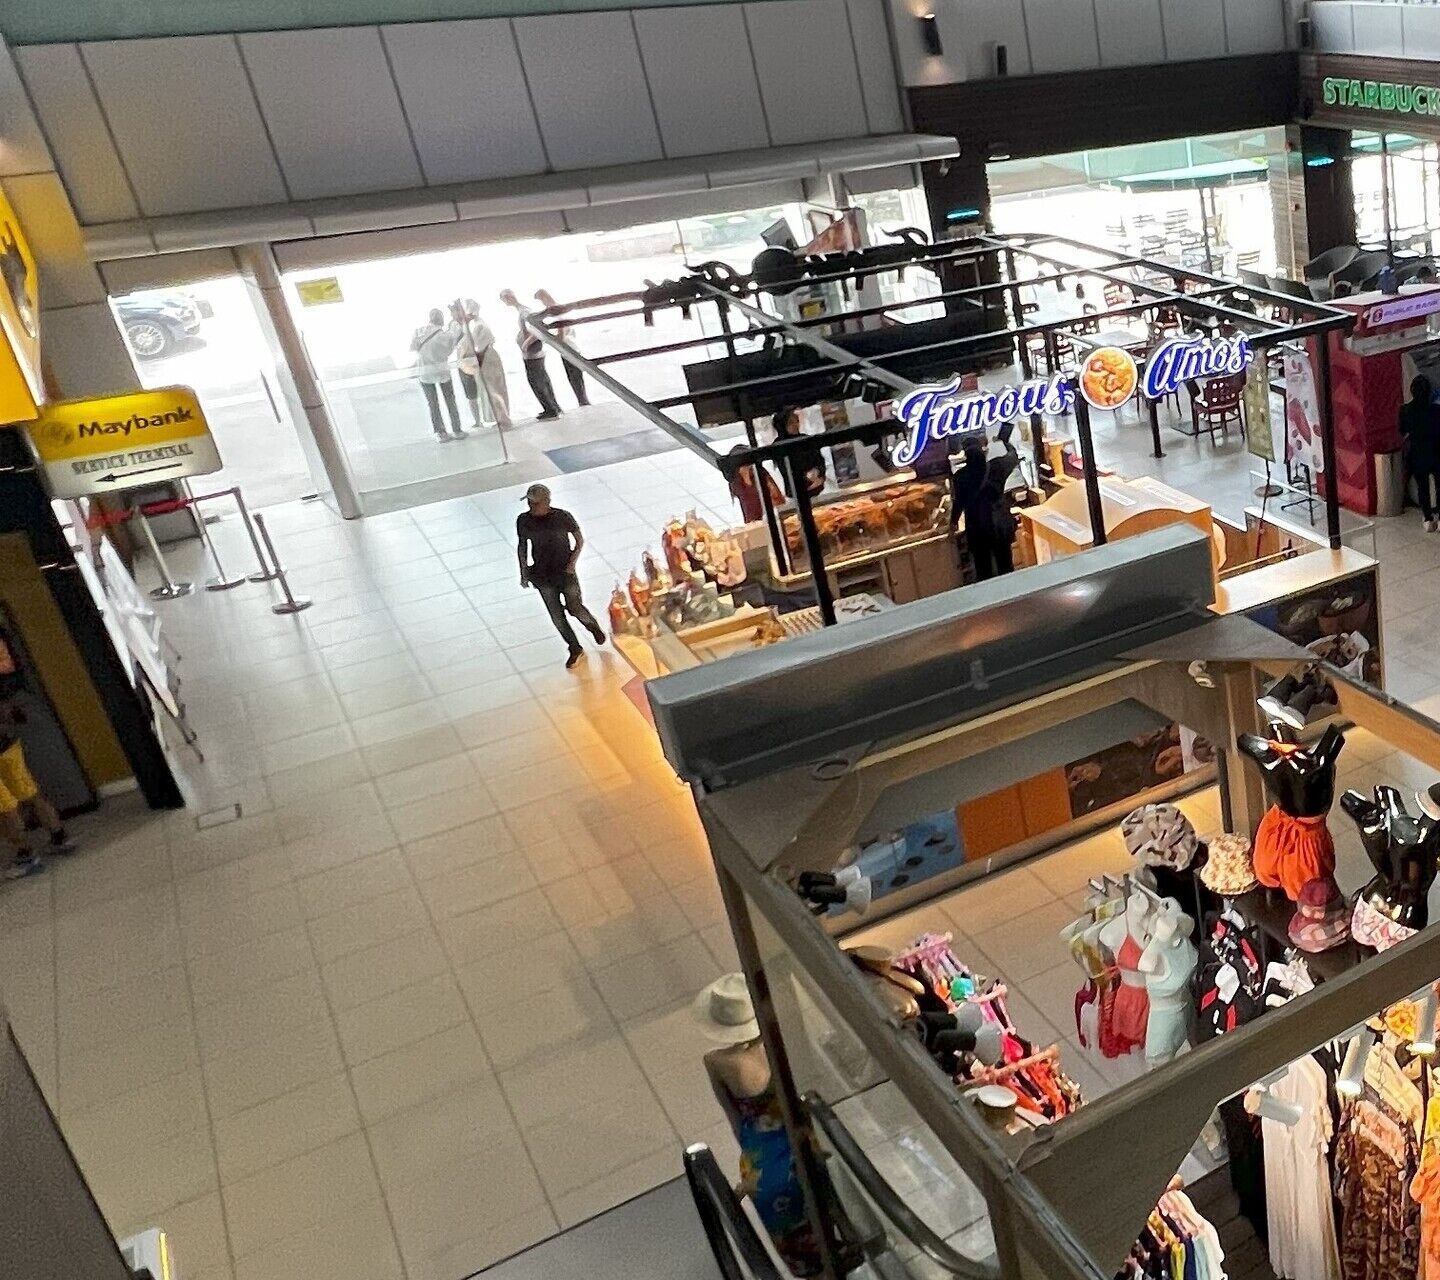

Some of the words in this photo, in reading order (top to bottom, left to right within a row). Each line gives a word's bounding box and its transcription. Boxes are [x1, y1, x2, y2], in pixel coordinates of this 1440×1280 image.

[78, 406, 193, 437] Maybank
[892, 372, 1076, 468] Famous
[1143, 330, 1255, 400] Amos
